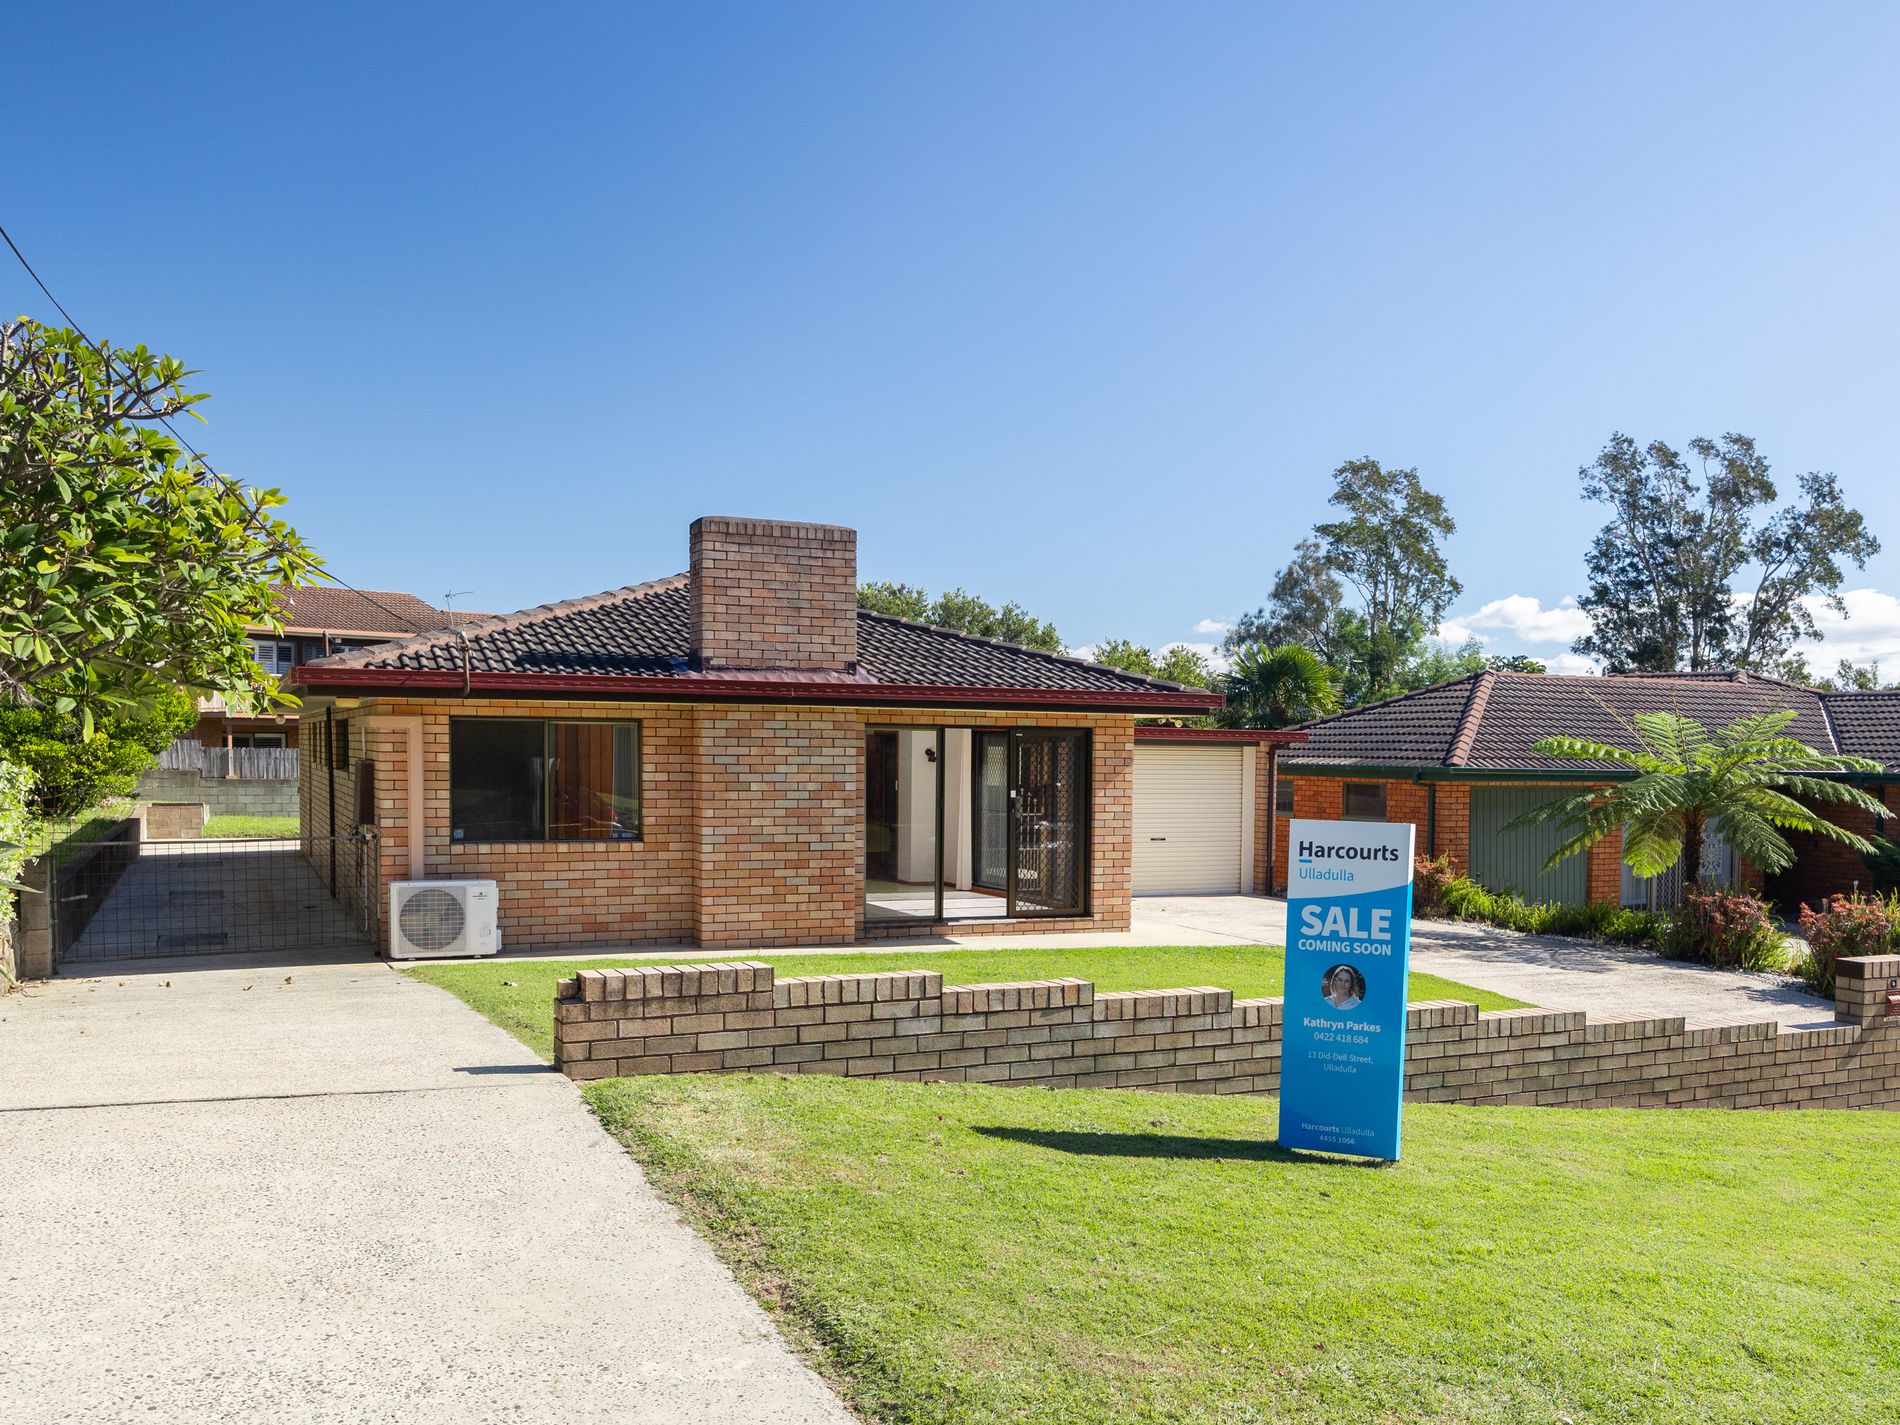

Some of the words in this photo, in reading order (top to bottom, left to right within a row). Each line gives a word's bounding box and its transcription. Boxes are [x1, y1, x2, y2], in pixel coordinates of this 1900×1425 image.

[1299, 841, 1399, 861] Harcourts
[1299, 867, 1354, 881] Ulladulla
[1300, 904, 1392, 940] SALE
[1298, 939, 1350, 953] COMING
[1353, 943, 1391, 956] SOON
[1303, 1017, 1344, 1031] Kathryn
[1346, 1021, 1381, 1032] Parkes
[1314, 1032, 1334, 1042] 0422
[1336, 1034, 1352, 1043] 418
[1353, 1035, 1369, 1044] 684
[1308, 1051, 1317, 1059] 13
[1318, 1051, 1348, 1062] Did-Dell
[1349, 1054, 1374, 1065] Street,
[1323, 1063, 1357, 1074] Ulladulla
[1301, 1122, 1340, 1134] Harcourts
[1341, 1126, 1375, 1137] Ulladulla
